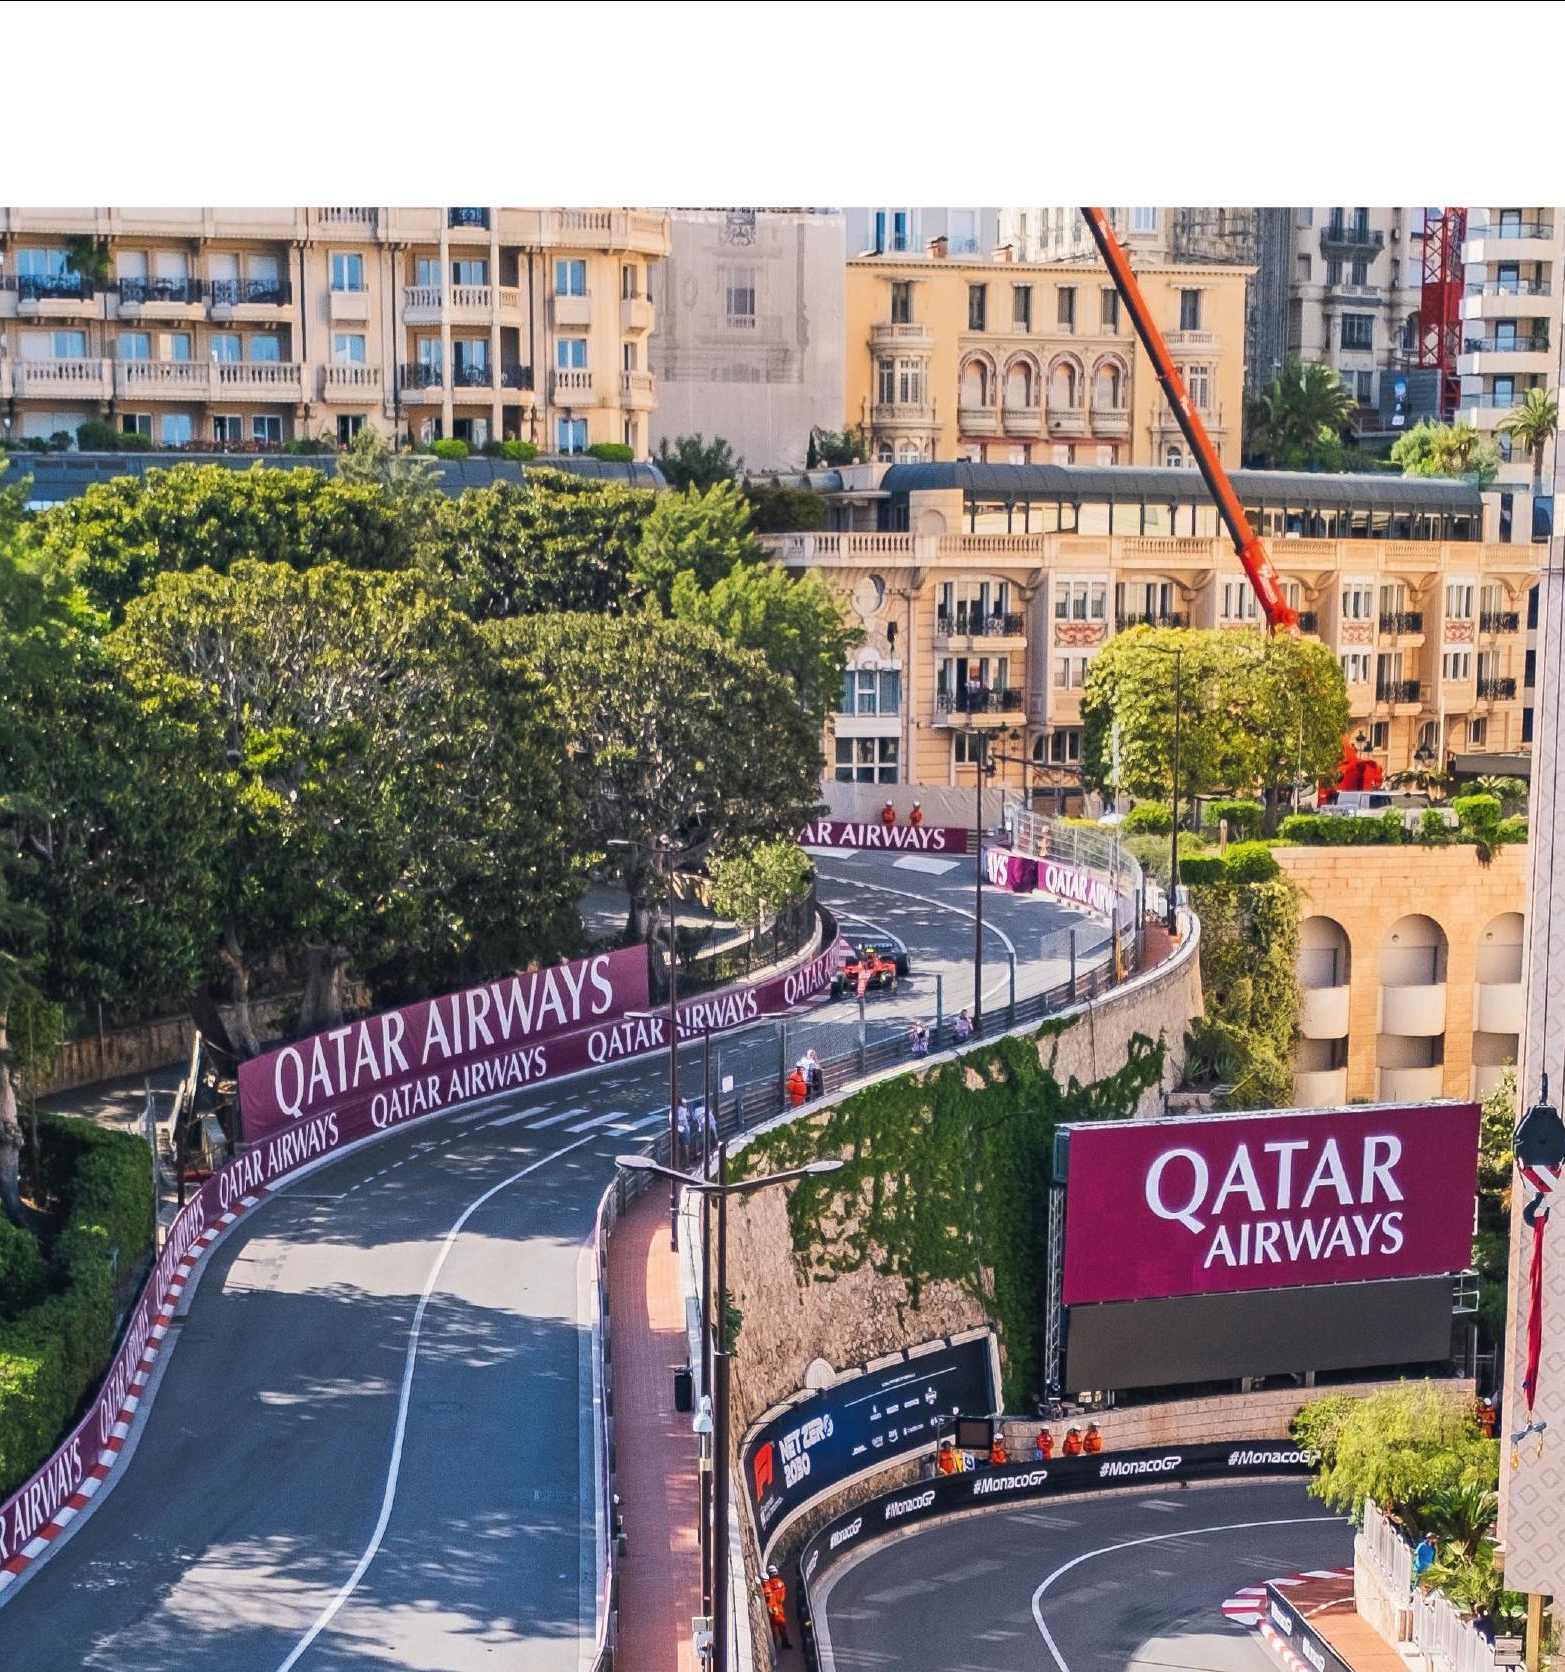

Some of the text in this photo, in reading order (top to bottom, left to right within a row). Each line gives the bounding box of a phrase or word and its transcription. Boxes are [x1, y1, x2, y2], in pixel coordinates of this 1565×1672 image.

[839, 823, 946, 850] AIRWAYS
[1045, 866, 1087, 899] QATAR
[784, 962, 825, 1006] QATAR
[274, 954, 615, 1118] QATAR AIRWAYS
[586, 1015, 665, 1065] QATAR
[370, 1045, 548, 1130] QATAR AIRWAYS
[218, 1111, 340, 1211] QATAR AIRWAYS
[1144, 1134, 1406, 1236] QATAR
[1203, 1210, 1406, 1269] AIRWAYS
[778, 1430, 802, 1465] NET
[1099, 1455, 1183, 1478] #MonacoGP
[12, 1434, 84, 1554] AIRWAYS
[972, 1470, 1048, 1496] #MonacoGP
